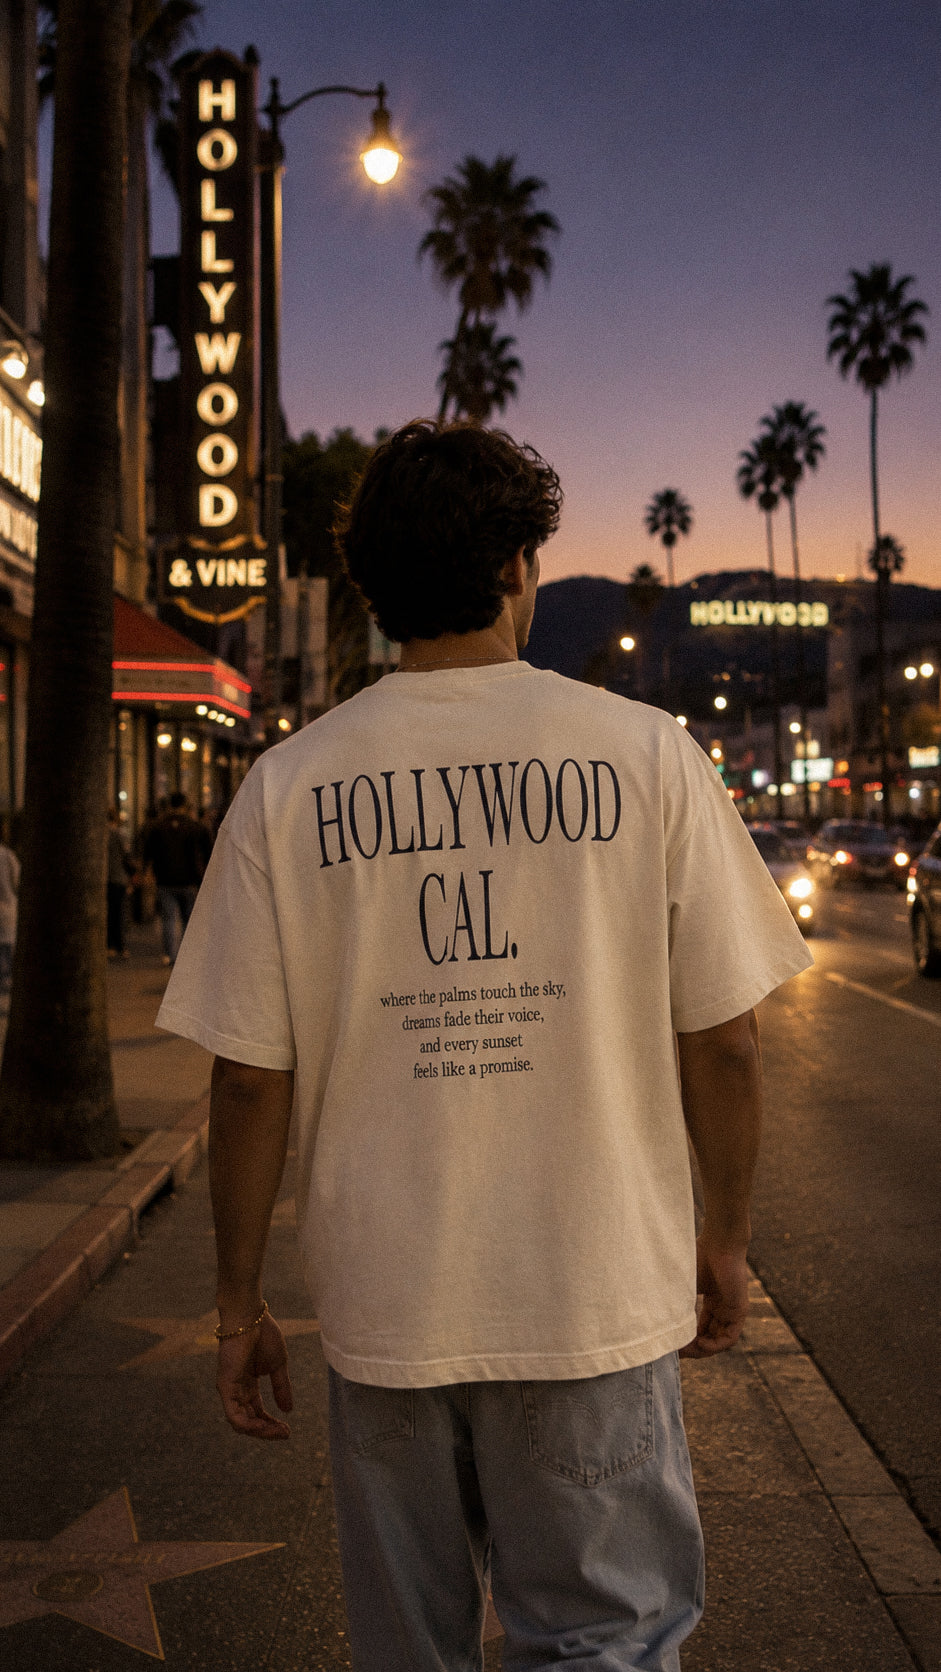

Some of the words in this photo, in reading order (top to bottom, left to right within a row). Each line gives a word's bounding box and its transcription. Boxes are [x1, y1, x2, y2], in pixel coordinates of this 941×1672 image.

[194, 78, 241, 528] HOLLYWOOD
[168, 559, 193, 588] &
[197, 558, 267, 588] VINE
[311, 758, 622, 869] HOLLYWOOD
[419, 870, 518, 966] CAL.
[380, 992, 416, 1008] where
[419, 989, 436, 1005] the
[439, 986, 477, 1007] palms
[480, 982, 516, 1000] touch
[519, 981, 539, 998] the
[542, 980, 566, 1000] sky,
[402, 1015, 441, 1031] dreams
[444, 1010, 471, 1027] fade
[474, 1008, 504, 1025] their
[508, 1007, 544, 1024] voice,
[419, 1037, 441, 1053] and
[444, 1038, 479, 1054] every
[482, 1033, 524, 1049] sunset
[413, 1062, 438, 1079] feels
[441, 1060, 465, 1077] like
[468, 1063, 476, 1075] a
[479, 1057, 534, 1078] promise.
